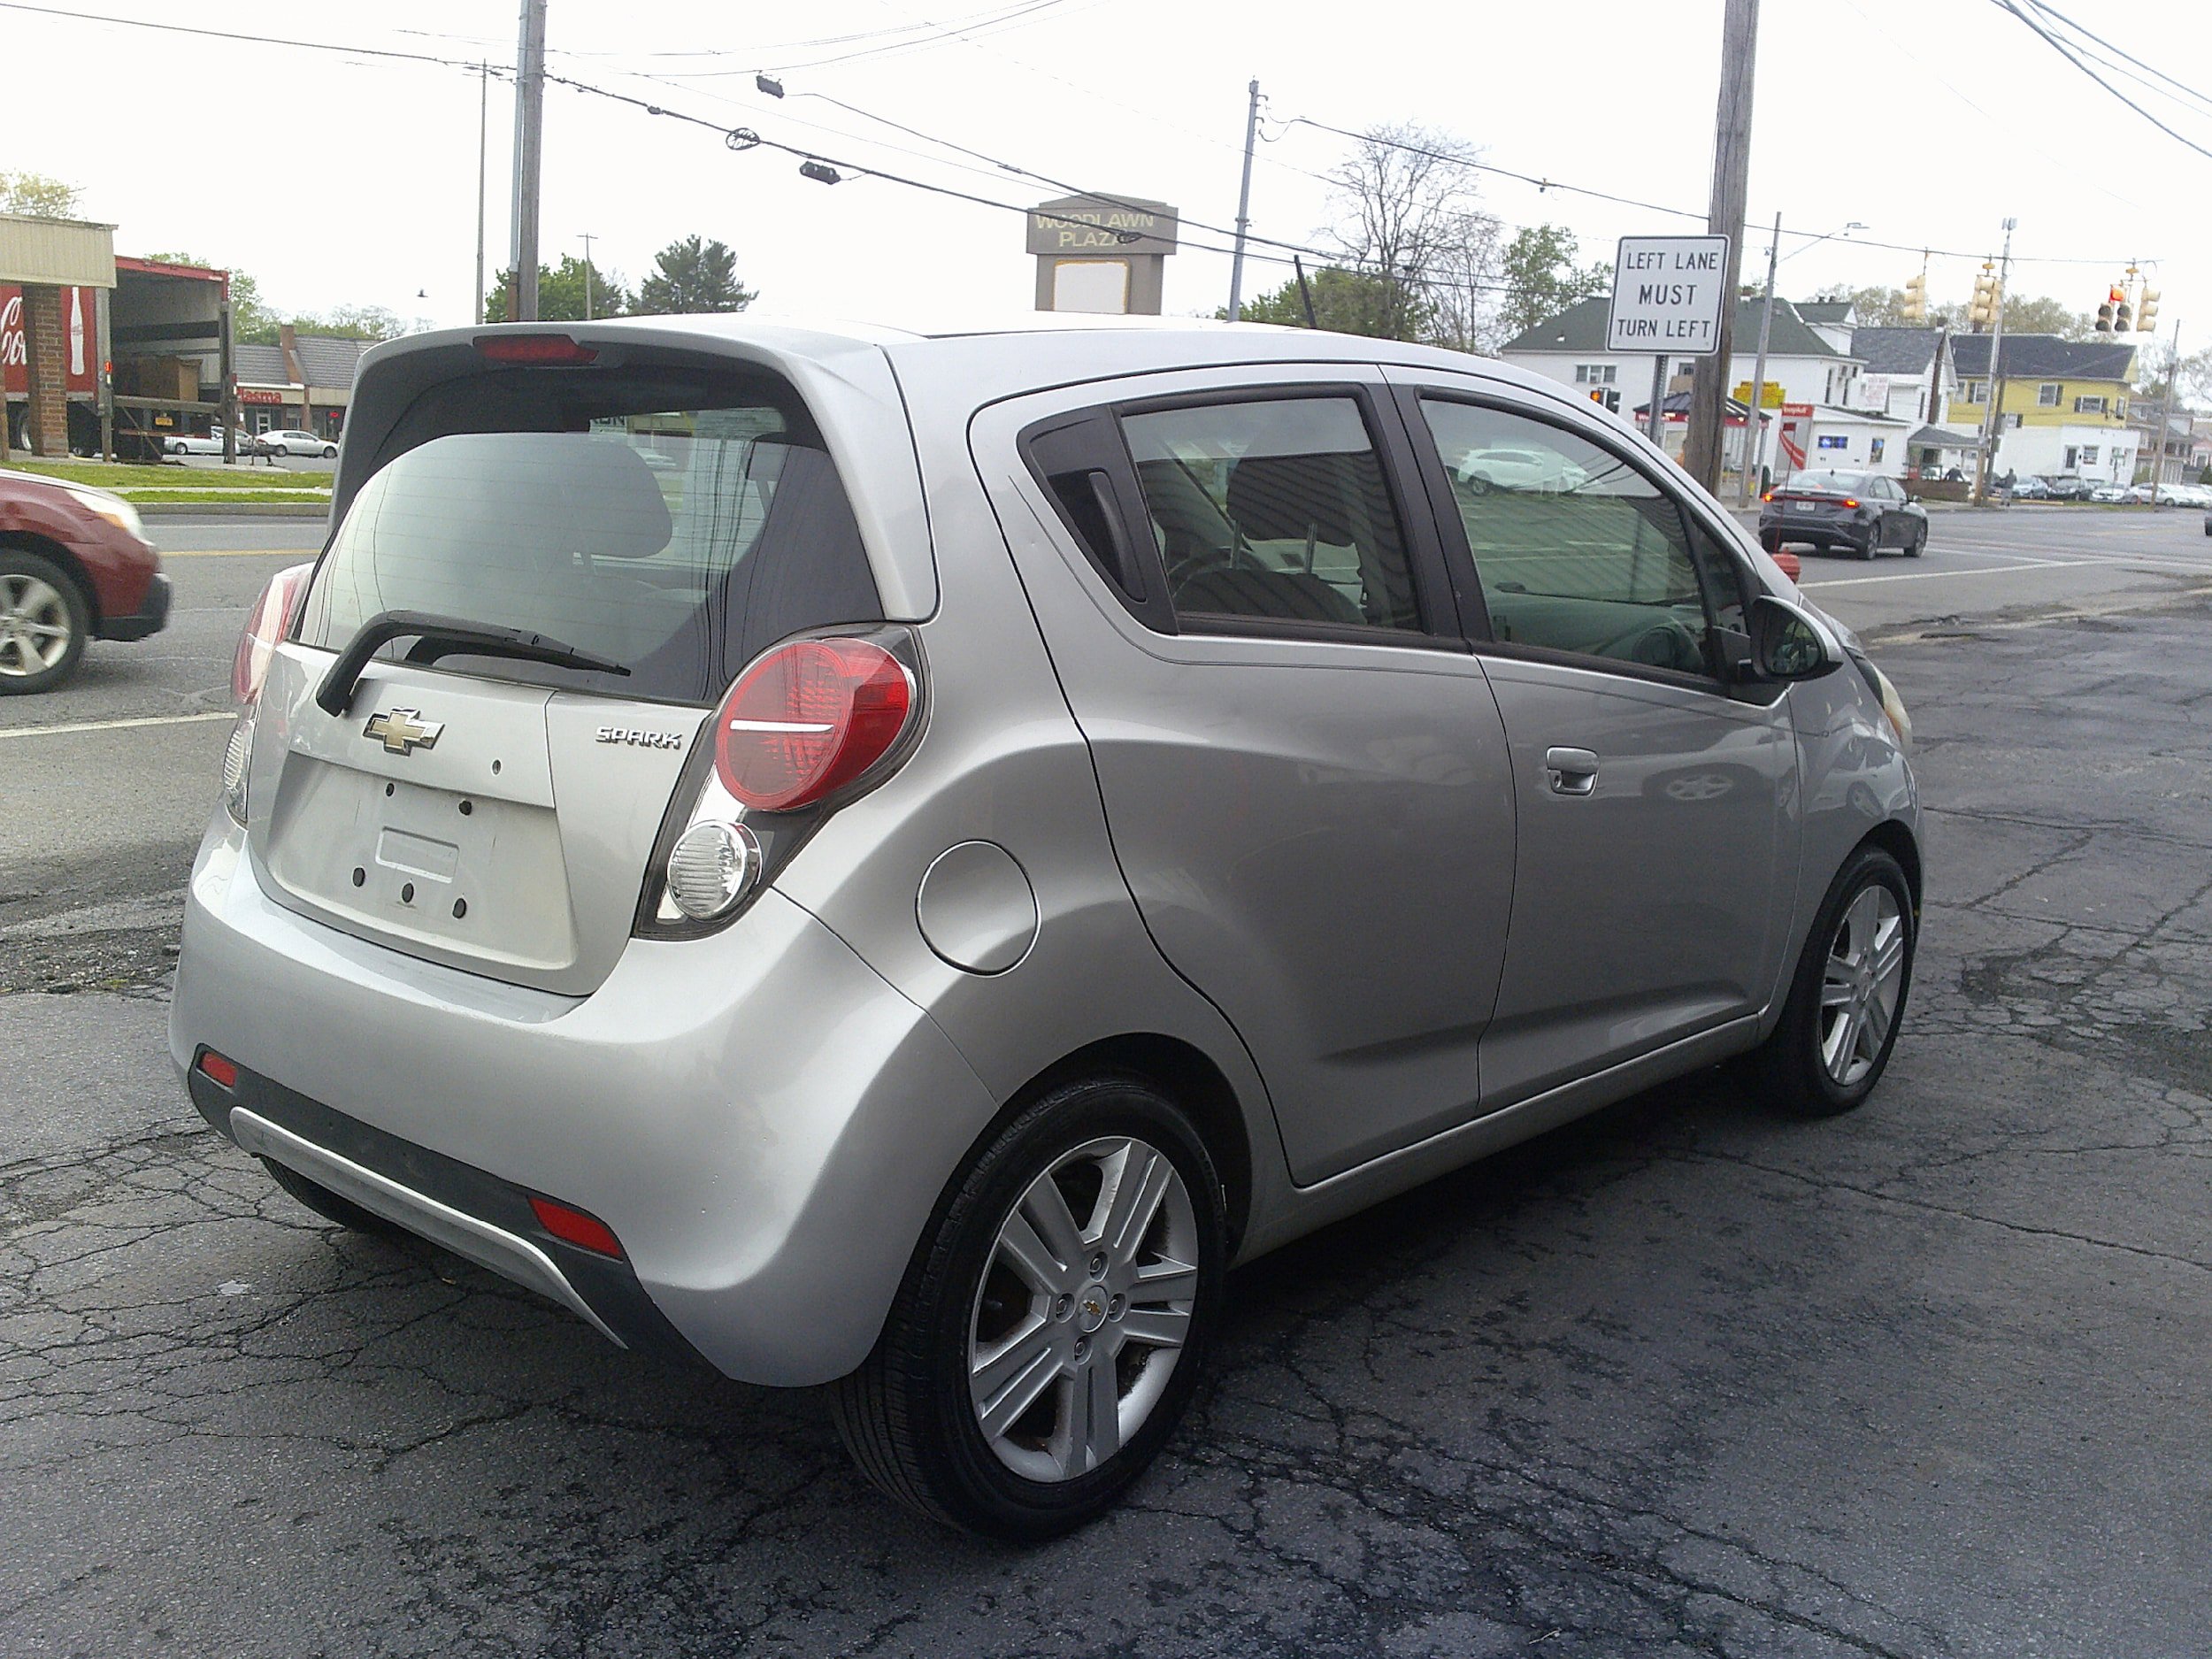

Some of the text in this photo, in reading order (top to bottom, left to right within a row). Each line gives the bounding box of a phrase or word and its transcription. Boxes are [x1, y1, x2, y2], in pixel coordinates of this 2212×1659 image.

[1038, 213, 1154, 228] WOODLAWN
[1060, 232, 1127, 247] PLAZA
[1627, 252, 1718, 270] LEFT LANE
[1639, 284, 1697, 305] MUST
[1617, 319, 1711, 338] TURN LEFT
[595, 726, 682, 749] SPARK
